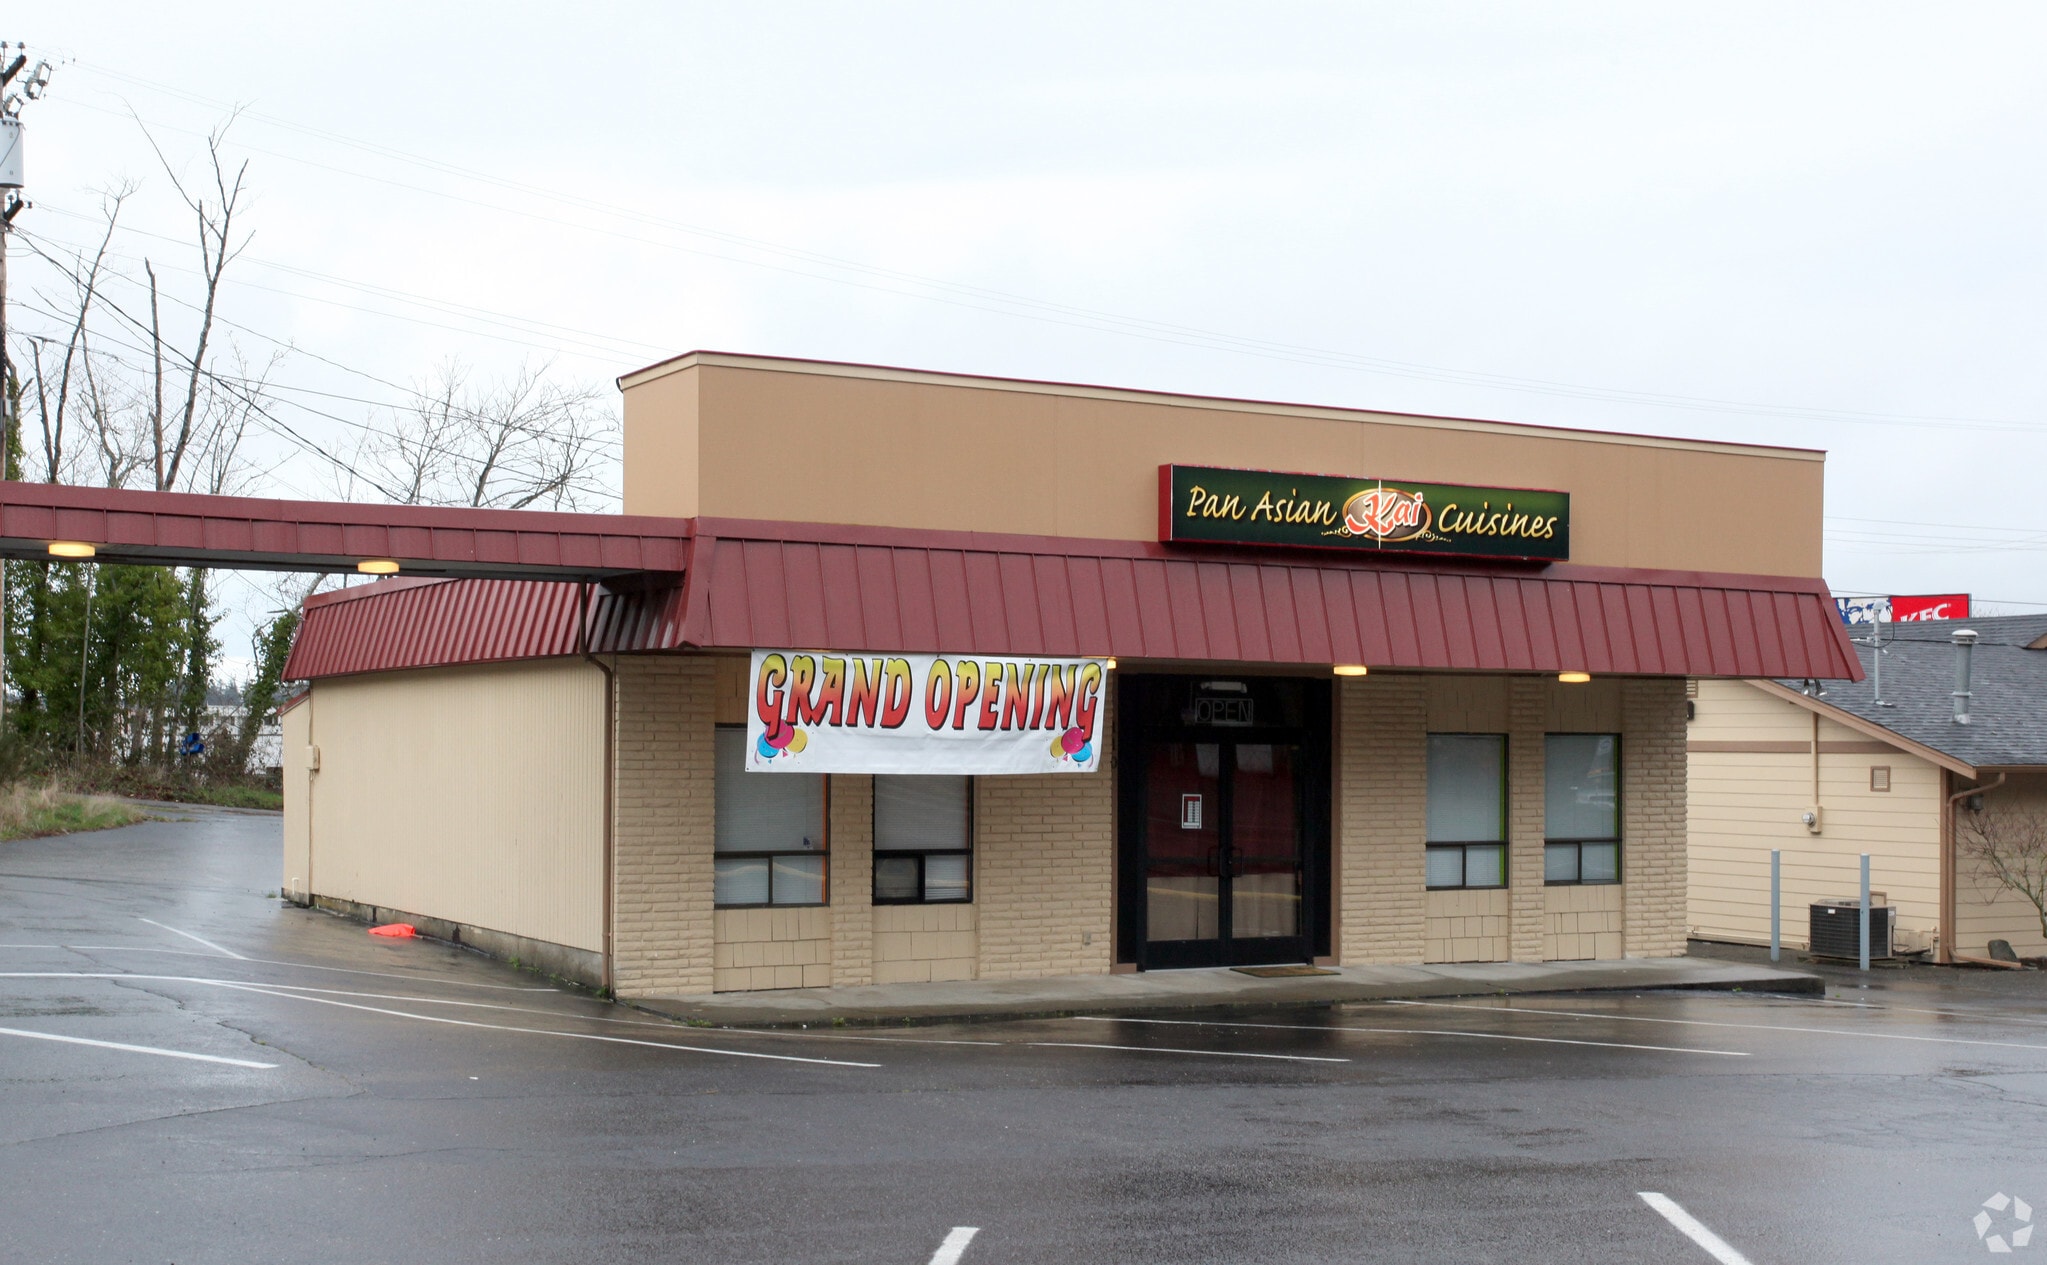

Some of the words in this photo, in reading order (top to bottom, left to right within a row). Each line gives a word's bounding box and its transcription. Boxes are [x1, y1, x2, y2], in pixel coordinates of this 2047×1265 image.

[1186, 485, 1248, 520] Pan
[1250, 489, 1338, 526] Asian
[1347, 492, 1424, 535] Kai
[1438, 503, 1558, 539] Cuisines
[756, 653, 912, 741] GRAND
[924, 658, 1102, 742] OPENING
[1198, 701, 1250, 722] OPEN
